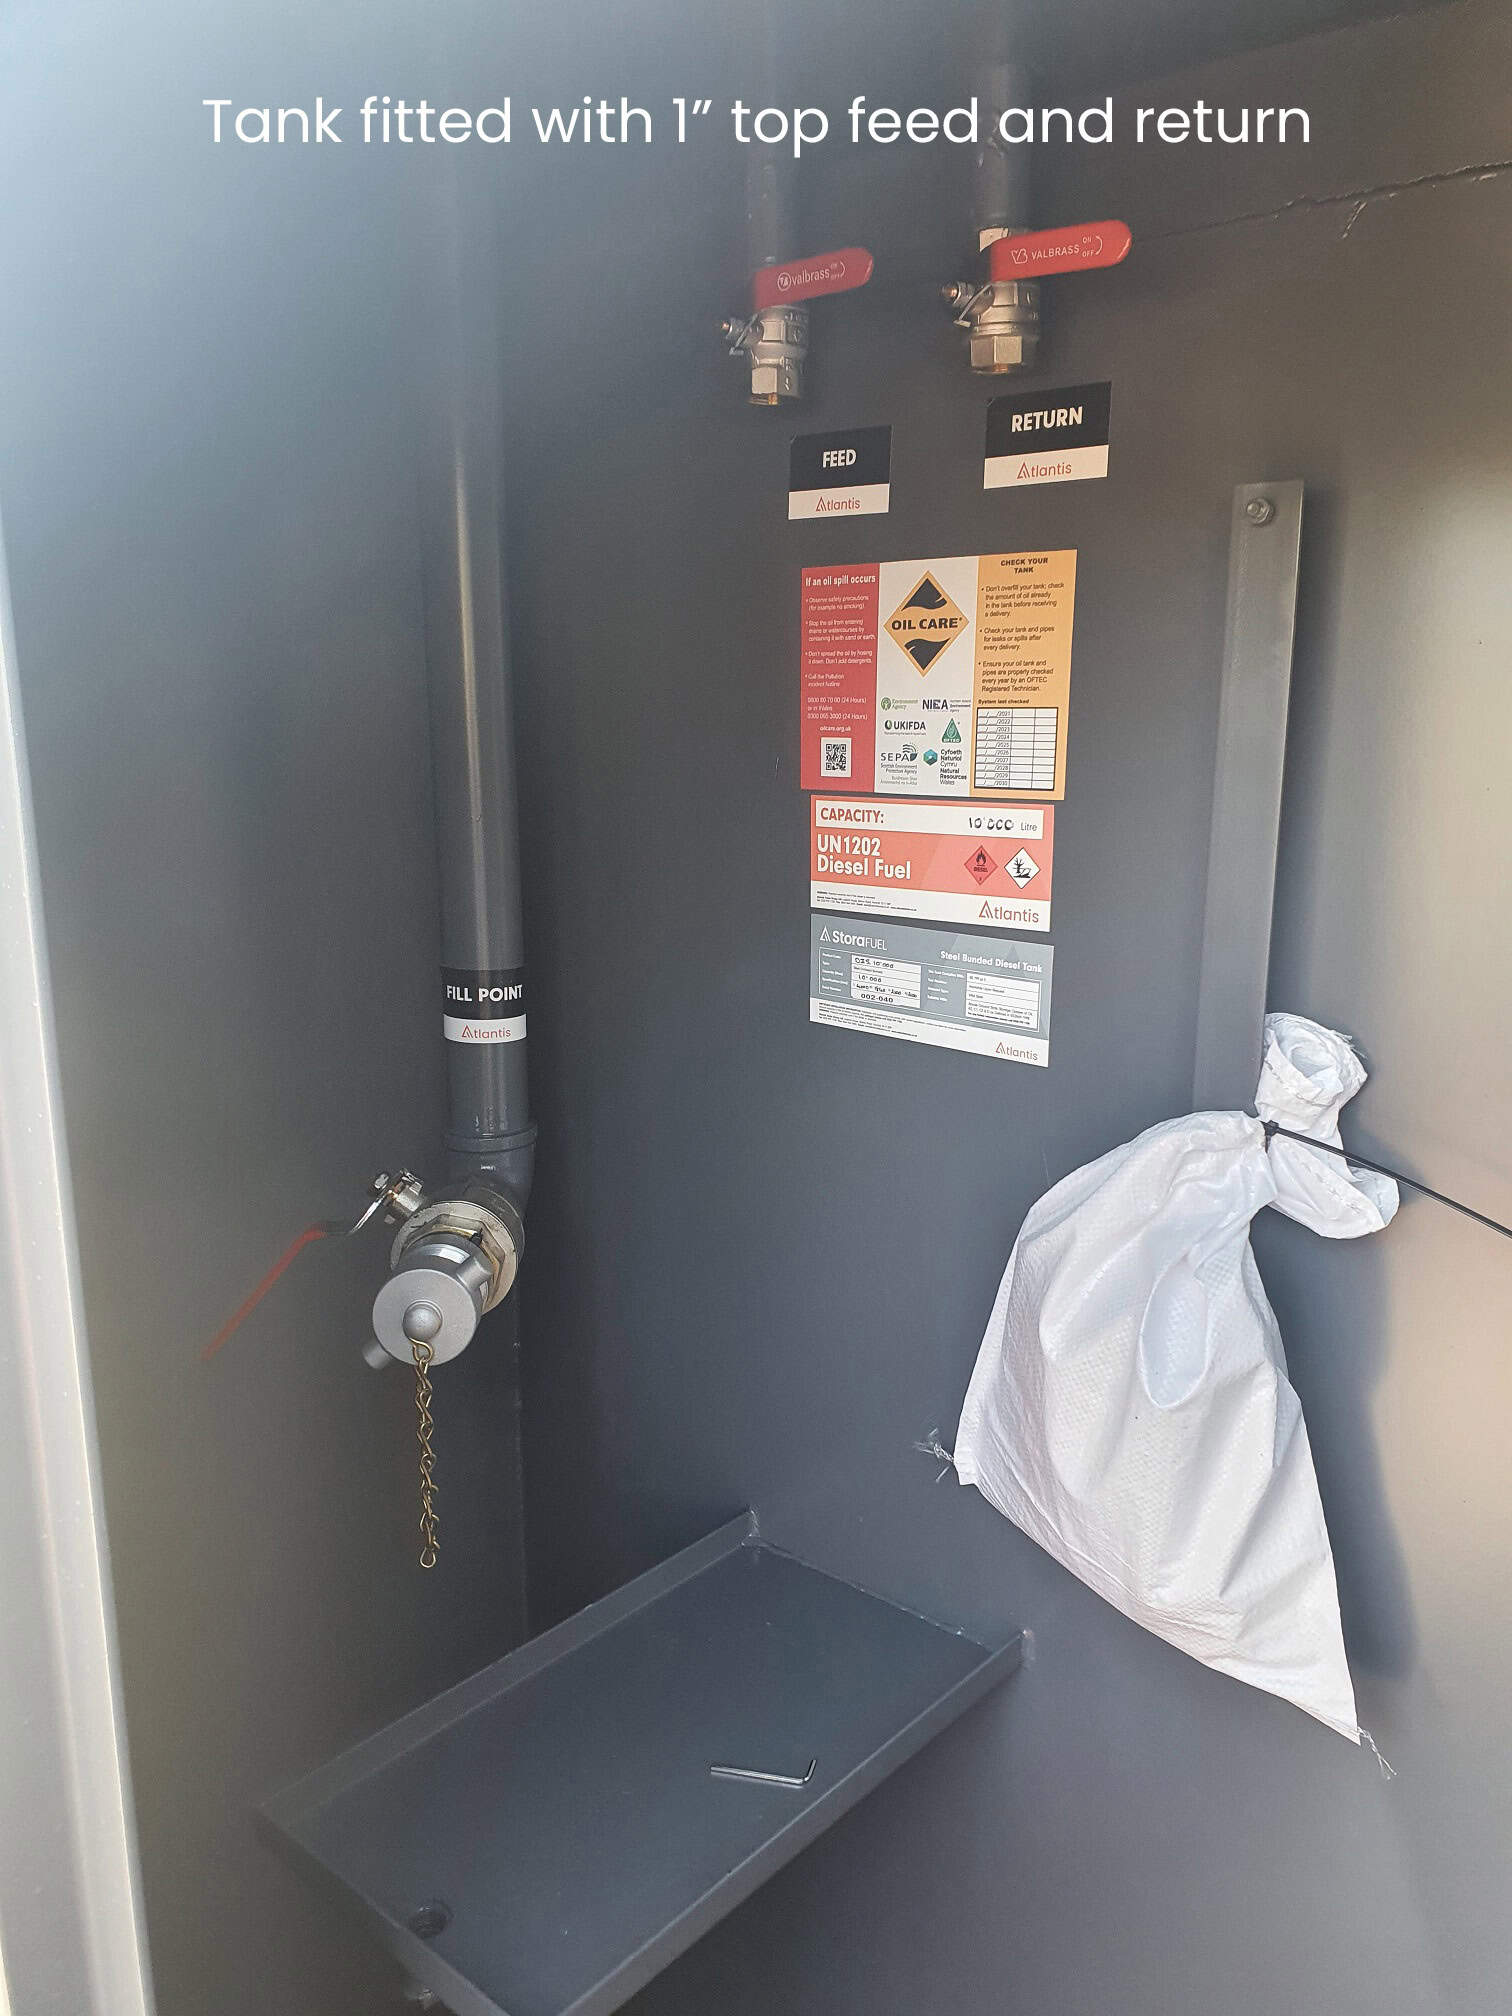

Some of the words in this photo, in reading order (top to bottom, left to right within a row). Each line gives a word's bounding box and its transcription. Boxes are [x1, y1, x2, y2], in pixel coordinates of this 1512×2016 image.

[1032, 244, 1080, 260] VALBRASS
[1082, 250, 1094, 258] OFF
[791, 268, 830, 286] valbrass
[1011, 406, 1083, 432] RETURN
[822, 449, 857, 468] FEED
[1016, 461, 1072, 480] Atlantis
[815, 496, 861, 512] Atlantis
[806, 577, 810, 586] If
[823, 576, 832, 585] oil
[834, 575, 848, 587] spill
[851, 575, 876, 583] occurs
[892, 620, 916, 630] OIL
[922, 699, 948, 710] NIEA
[893, 721, 926, 730] UKIFDA
[880, 753, 909, 762] SEPA
[820, 807, 884, 824] CAPACITY:
[1020, 822, 1037, 831] Litre
[817, 833, 881, 856] UN1202
[817, 855, 868, 876] Diesel
[875, 858, 911, 880] Fuel
[979, 900, 1039, 923] Atlantis
[832, 930, 887, 951] StoraFUEL
[941, 951, 960, 960] Steel
[963, 954, 993, 965] Bunded
[995, 959, 1020, 969] Diesel
[1022, 962, 1042, 973] Tank
[446, 985, 472, 1002] FILL
[478, 984, 523, 1002] POINT
[461, 1025, 511, 1039] Atlantis
[996, 1042, 1038, 1060] Atlantis
